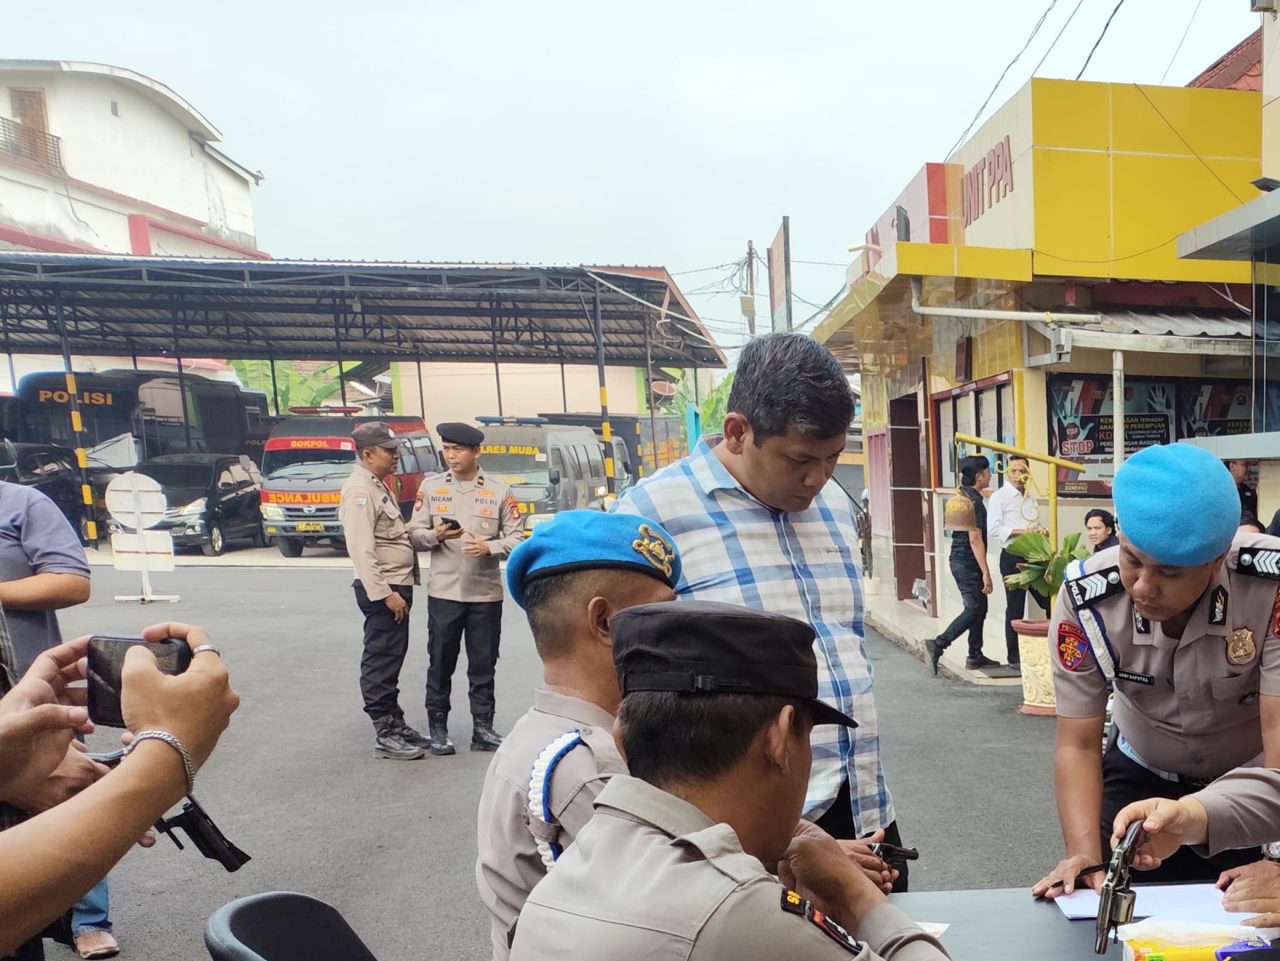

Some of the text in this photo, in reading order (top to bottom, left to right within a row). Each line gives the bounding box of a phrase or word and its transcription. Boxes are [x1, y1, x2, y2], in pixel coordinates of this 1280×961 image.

[961, 134, 1014, 230] UNIT PPA
[290, 440, 329, 448] DOKPOL
[480, 445, 539, 455] LRES MUBA
[1062, 440, 1095, 455] STOP
